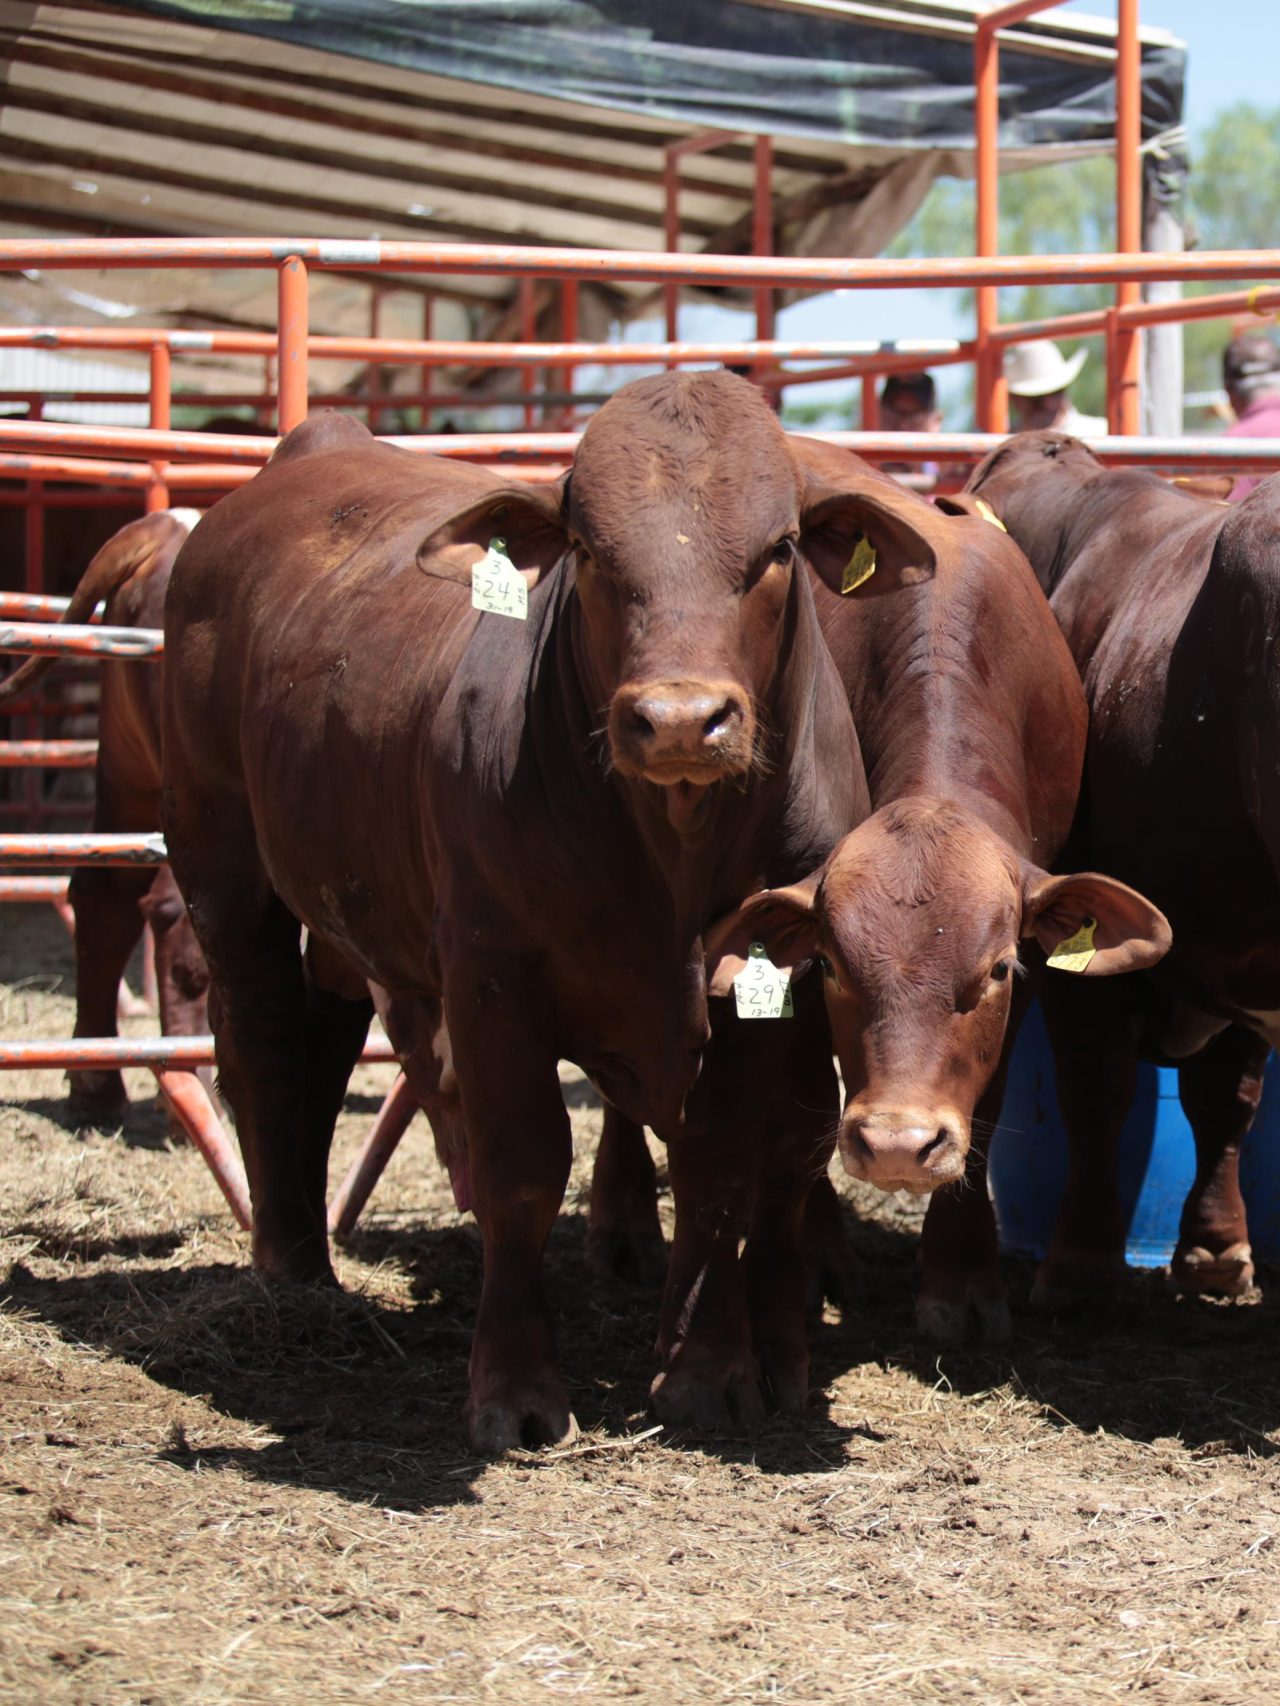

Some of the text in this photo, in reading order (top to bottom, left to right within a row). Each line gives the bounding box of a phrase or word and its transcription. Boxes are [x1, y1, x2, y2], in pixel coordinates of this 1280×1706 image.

[490, 560, 501, 575] 3
[482, 580, 510, 600] 24
[754, 965, 765, 980] 3
[748, 984, 774, 1005] 29
